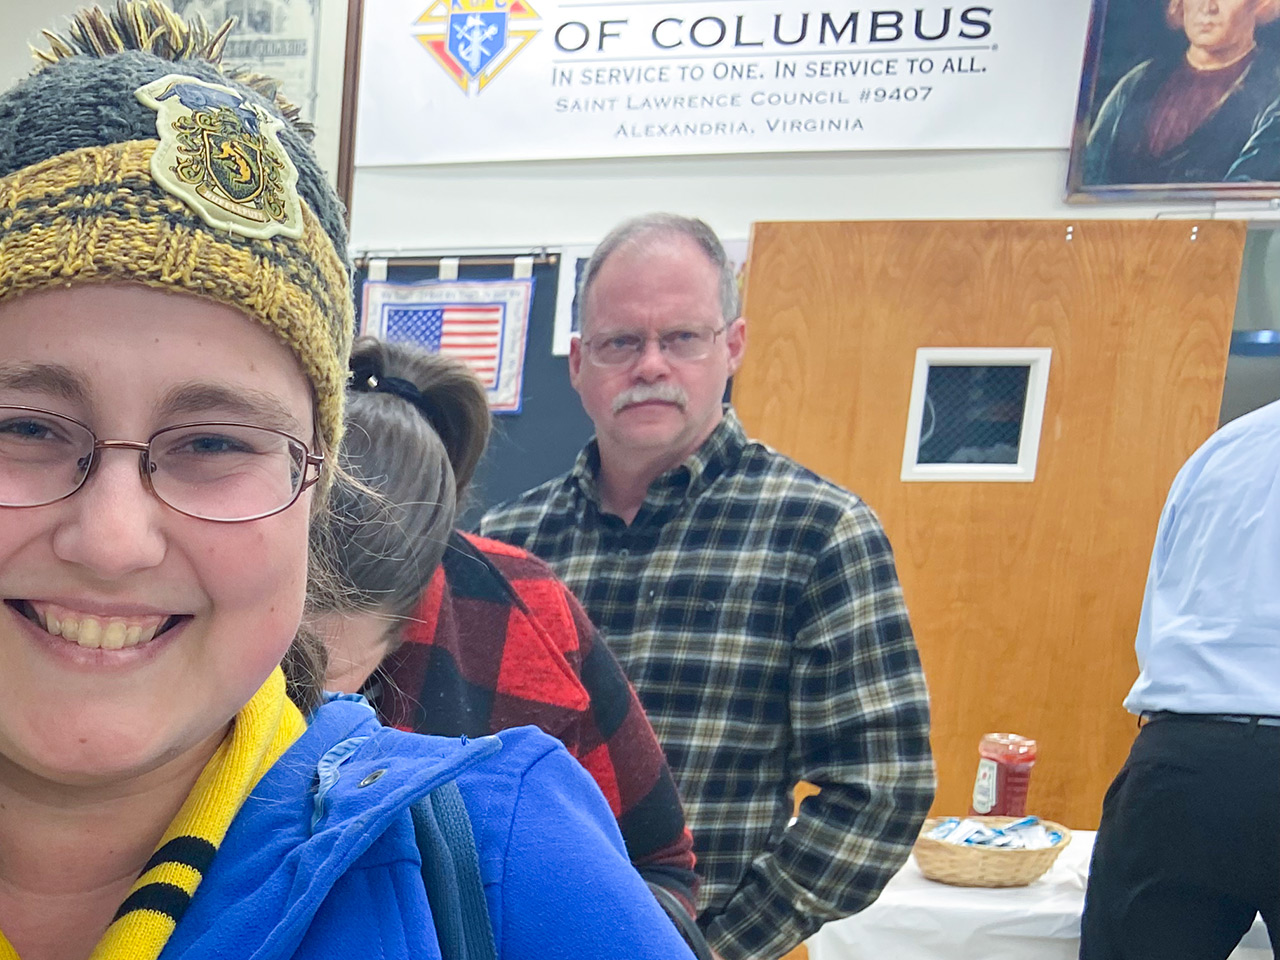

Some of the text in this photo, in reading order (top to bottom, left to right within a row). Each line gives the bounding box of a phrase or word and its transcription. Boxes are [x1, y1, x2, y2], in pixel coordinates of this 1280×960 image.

[554, 7, 993, 52] OF COLUMBUS
[552, 56, 987, 87] IN SERVICE TO ONE. IN SERVICE TO ALL.
[555, 86, 933, 113] SAINT LAWRENCE COUNCIL #9407
[766, 118, 864, 133] VIRGINIA
